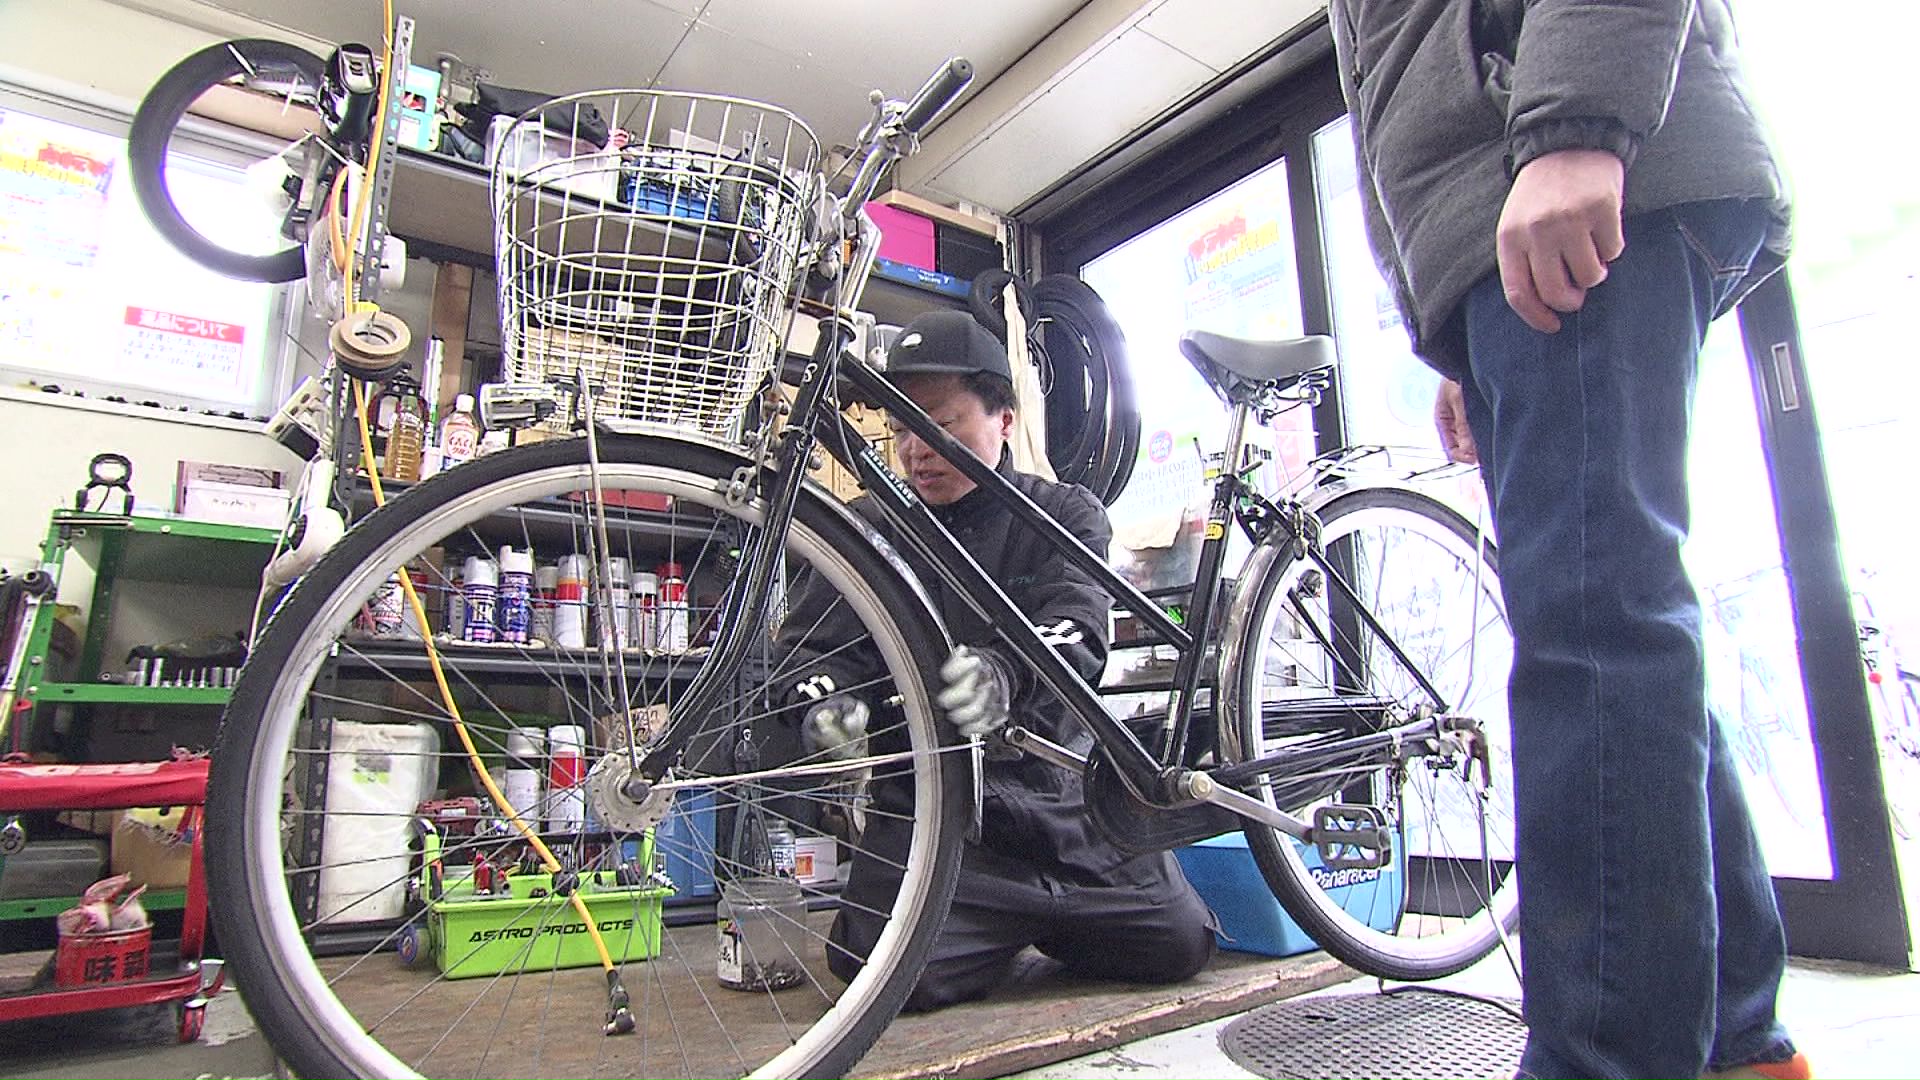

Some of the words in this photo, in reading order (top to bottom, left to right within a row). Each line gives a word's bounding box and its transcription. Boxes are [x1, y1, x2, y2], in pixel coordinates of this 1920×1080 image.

[1311, 868, 1379, 889] Panaracer
[469, 927, 533, 942] ASTRO
[537, 919, 635, 937] PRODCTS
